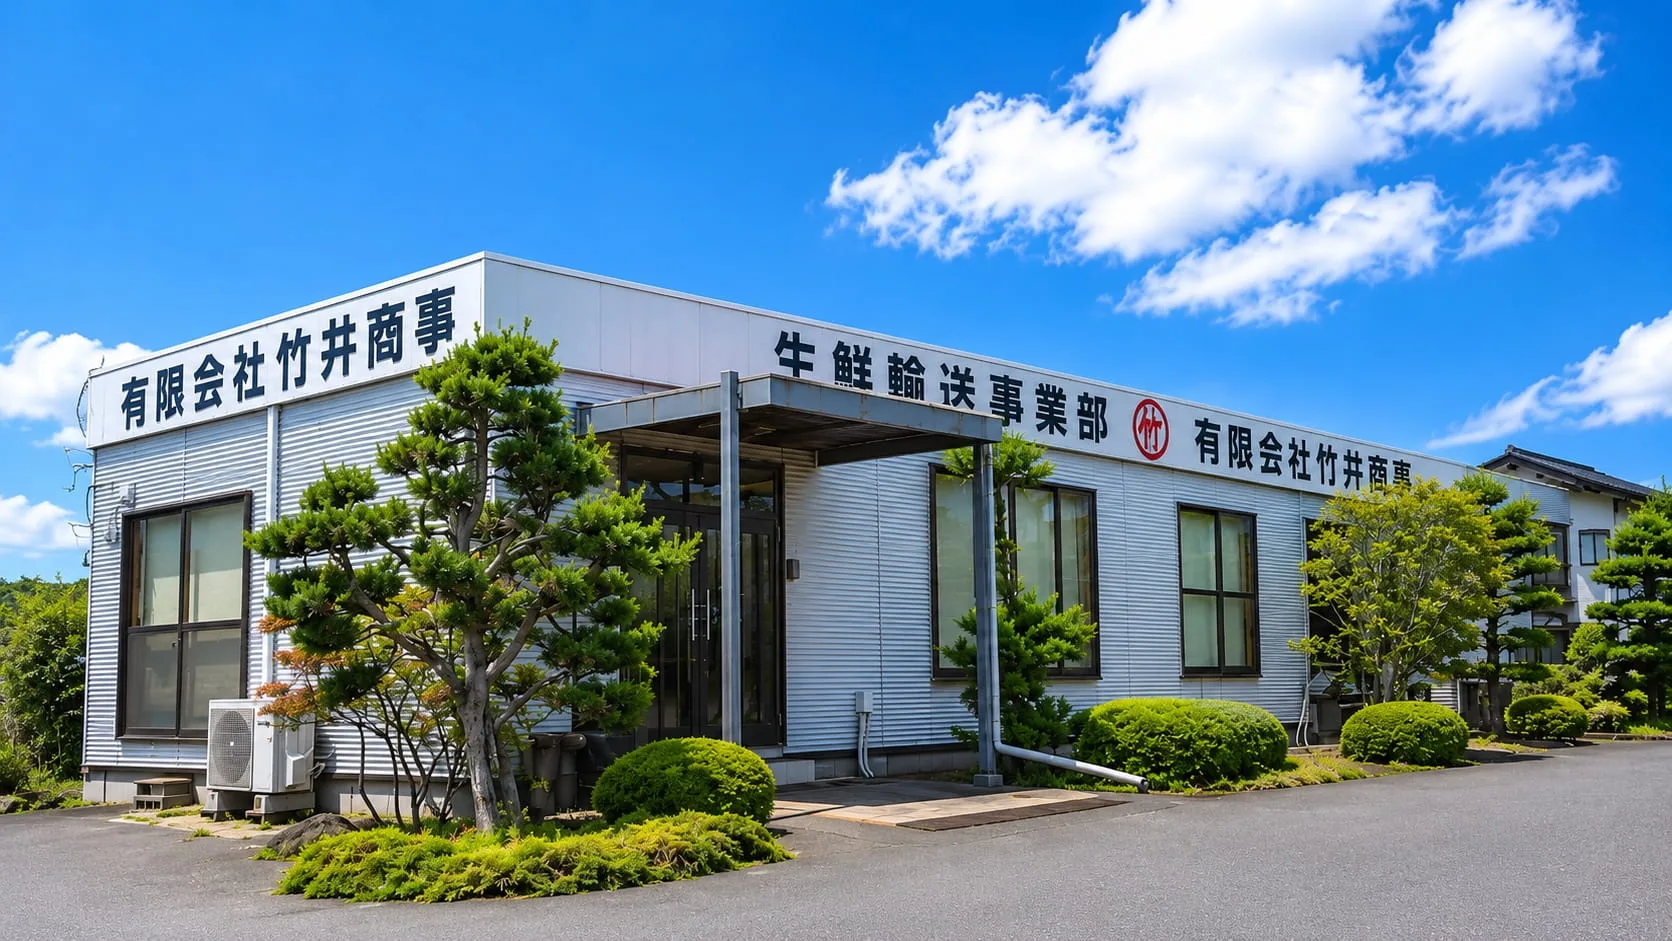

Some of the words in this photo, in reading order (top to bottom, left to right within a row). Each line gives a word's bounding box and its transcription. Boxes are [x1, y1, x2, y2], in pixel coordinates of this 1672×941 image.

[121, 285, 456, 430] 有限会社竹井商事
[1136, 404, 1164, 453] 竹
